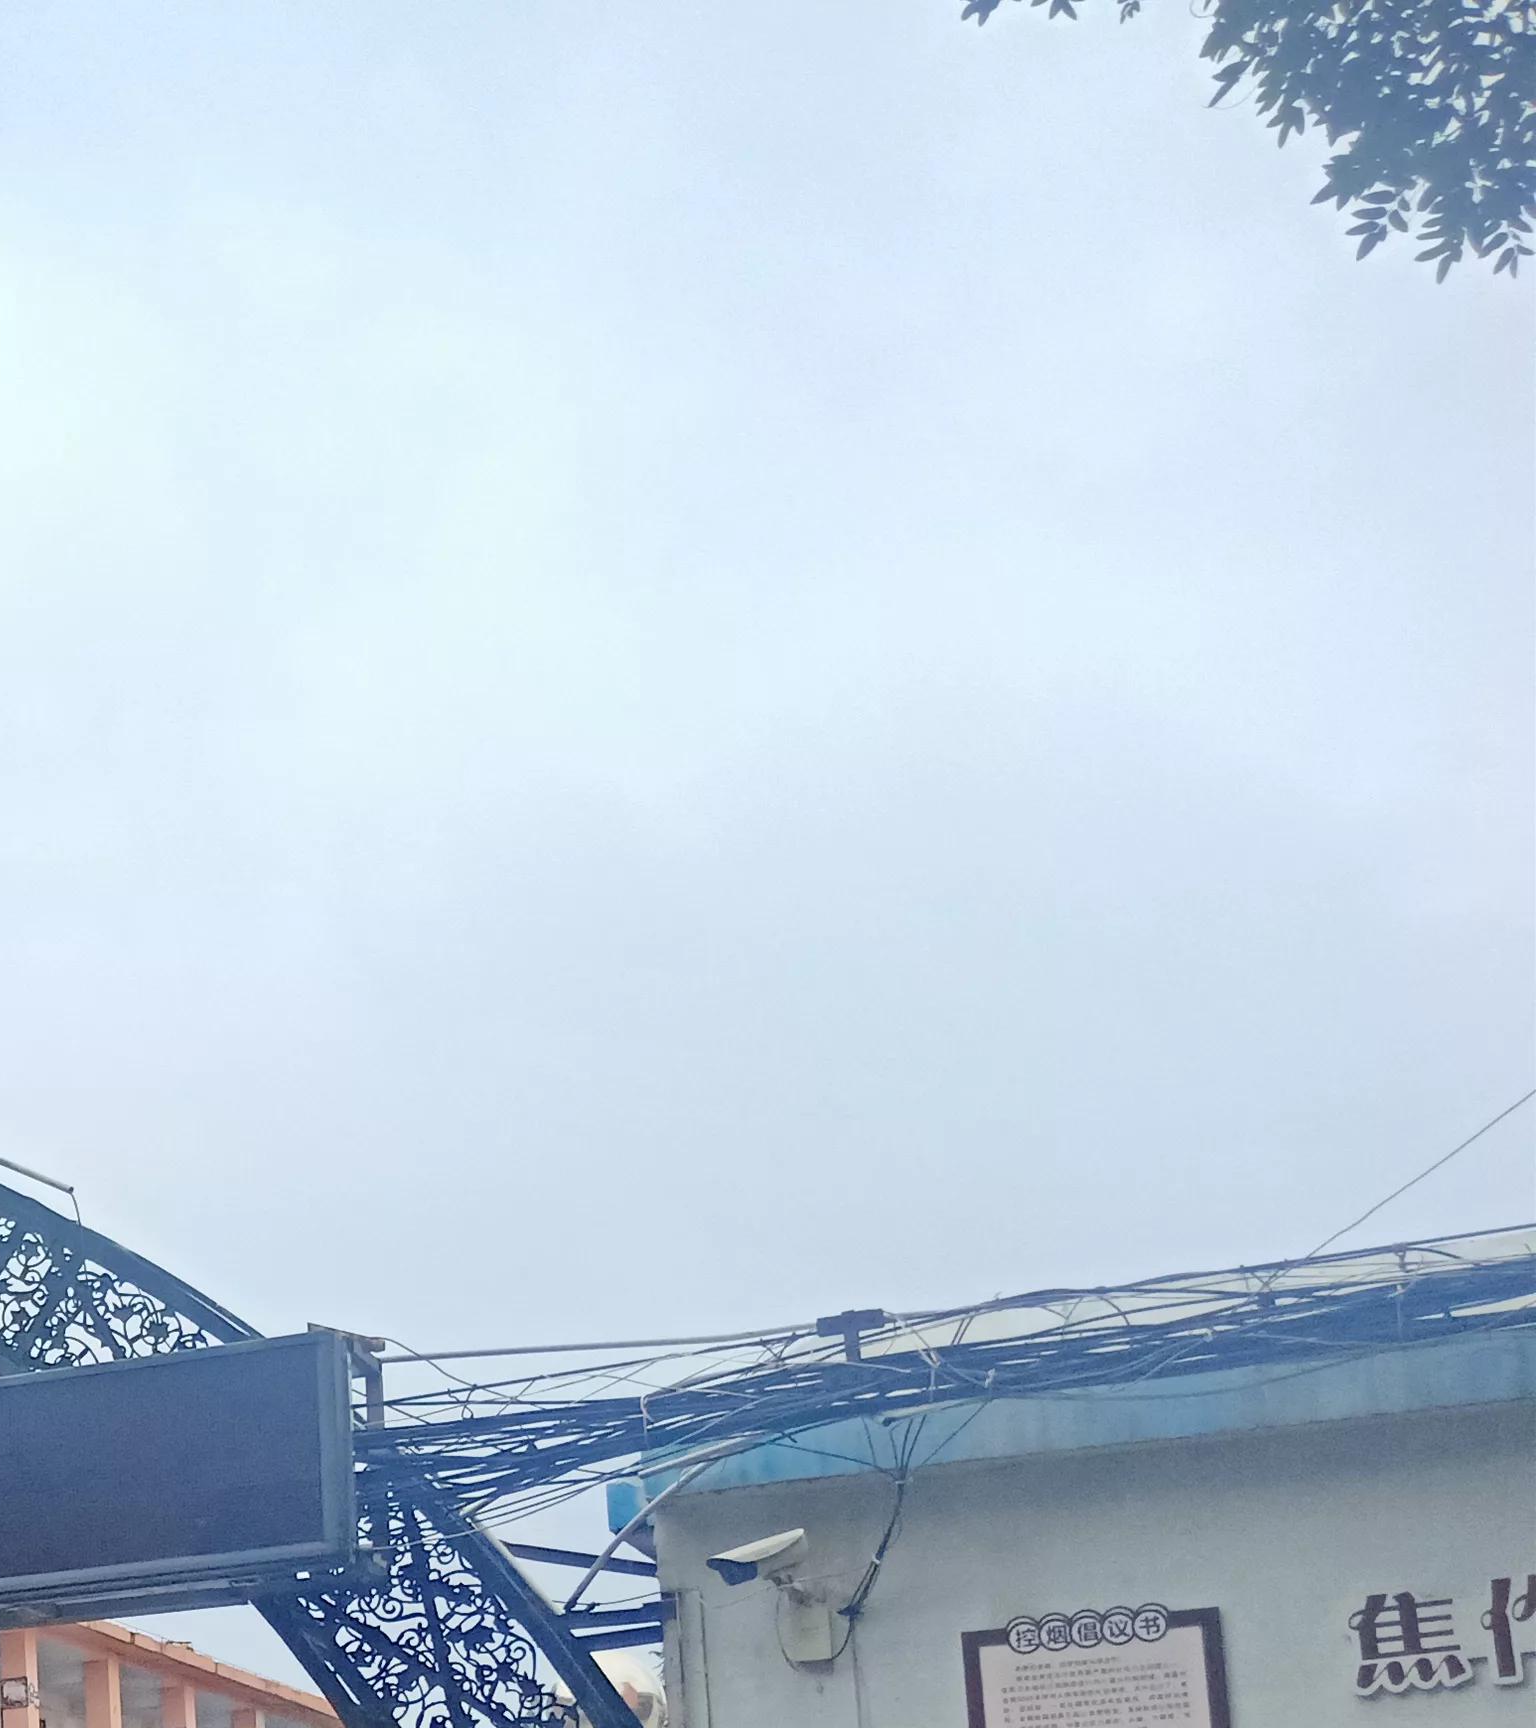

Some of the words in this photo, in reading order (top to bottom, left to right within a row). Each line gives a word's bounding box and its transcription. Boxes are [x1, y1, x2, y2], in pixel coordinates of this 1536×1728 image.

[1012, 1611, 1165, 1651] 控烟倡议书
